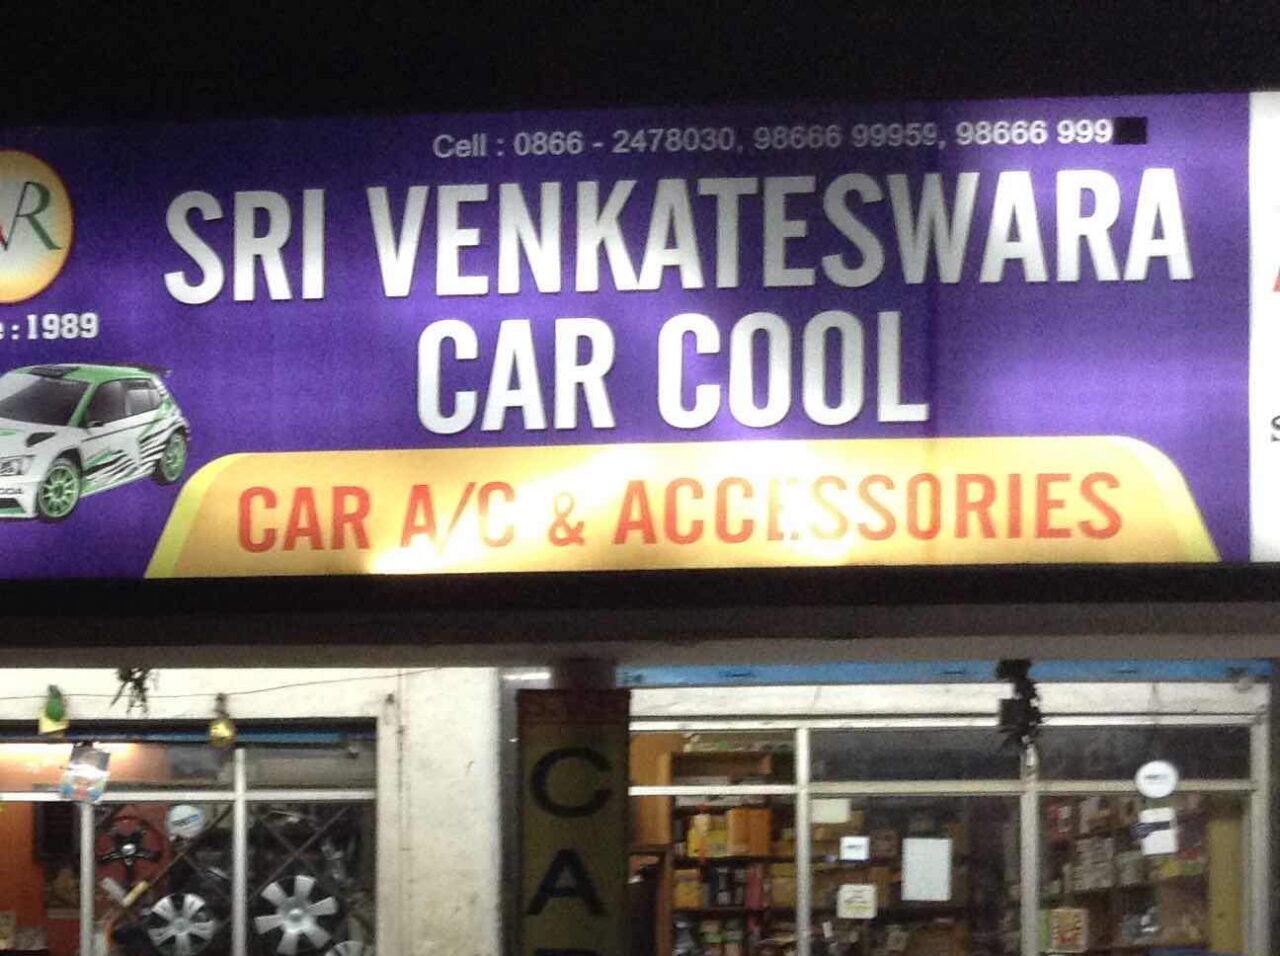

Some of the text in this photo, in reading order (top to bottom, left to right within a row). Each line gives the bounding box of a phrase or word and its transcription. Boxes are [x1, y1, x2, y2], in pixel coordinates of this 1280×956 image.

[432, 133, 486, 158] Cell
[514, 131, 584, 156] 0866
[753, 123, 842, 150] 98666
[956, 119, 1048, 145] 98666
[1056, 118, 1115, 144] 999
[164, 168, 1194, 304] SRI VENKATESWARA
[26, 312, 99, 340] 1989
[416, 310, 930, 435] CAR COOL
[238, 471, 1123, 554] CAR A/C & ACCESSORIES
